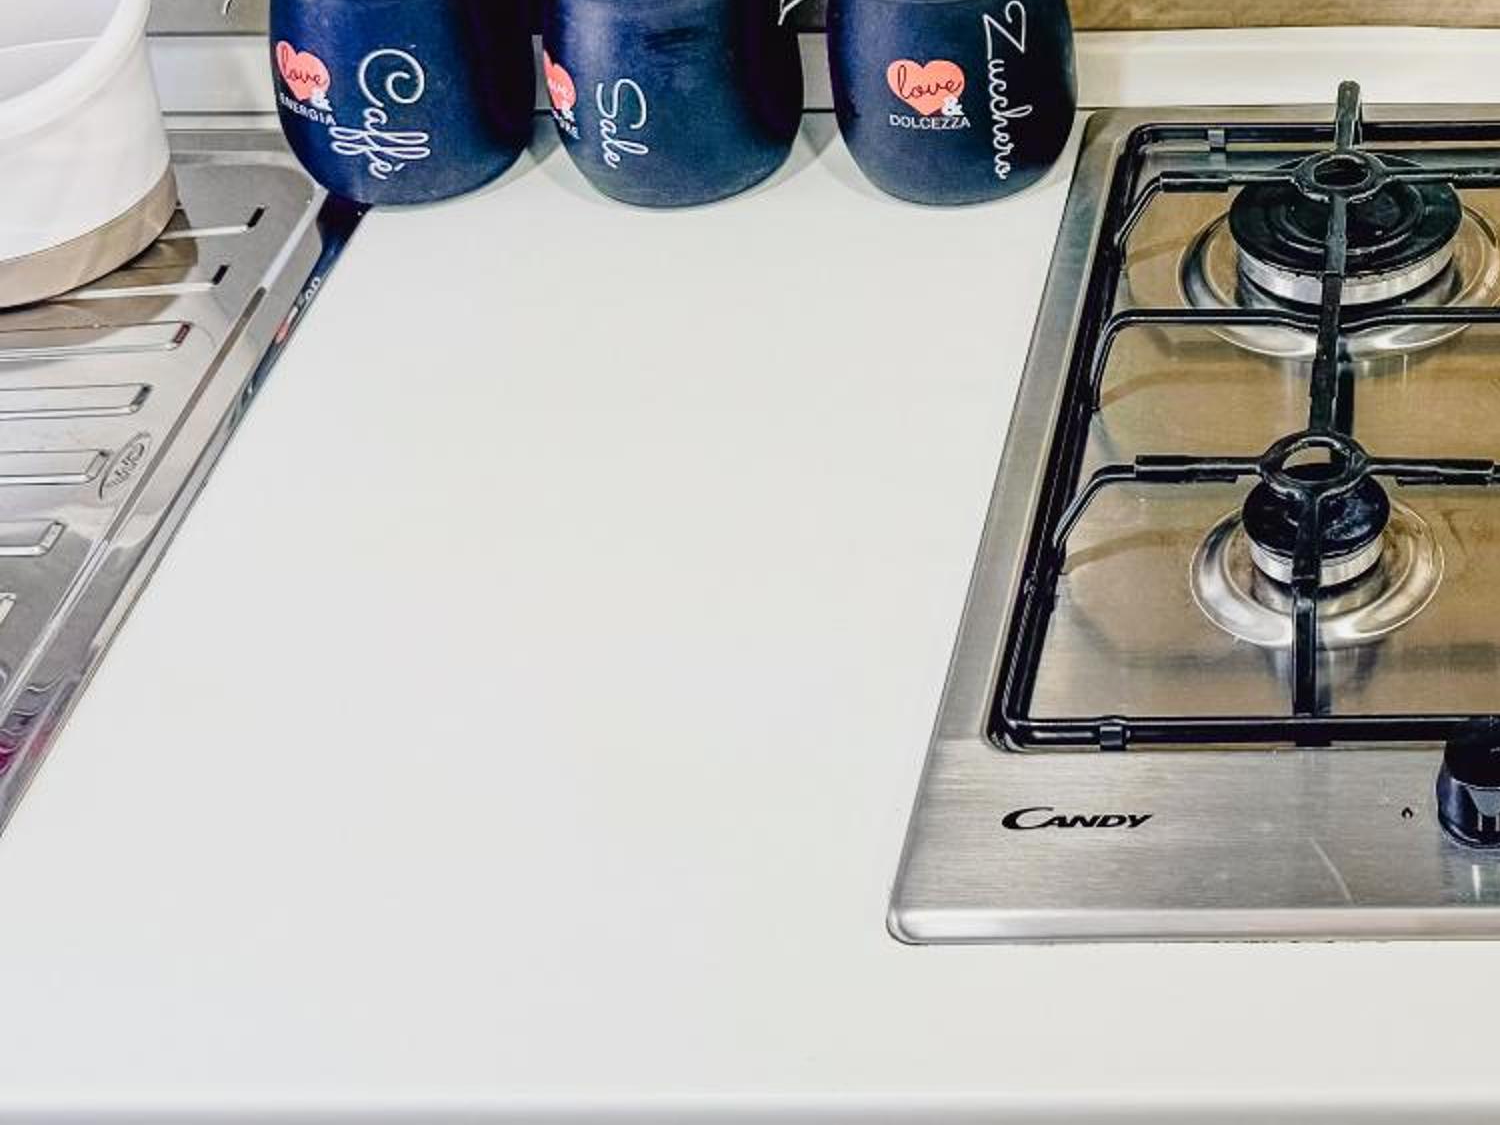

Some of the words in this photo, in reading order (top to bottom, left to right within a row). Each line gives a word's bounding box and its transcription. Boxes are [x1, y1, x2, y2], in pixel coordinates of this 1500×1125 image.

[277, 46, 321, 85] love
[897, 64, 962, 100] love
[982, 0, 1033, 180] Zucchero
[596, 78, 649, 168] Sale
[889, 113, 971, 131] DOLCEZZA
[1001, 806, 1153, 830] CANDY
